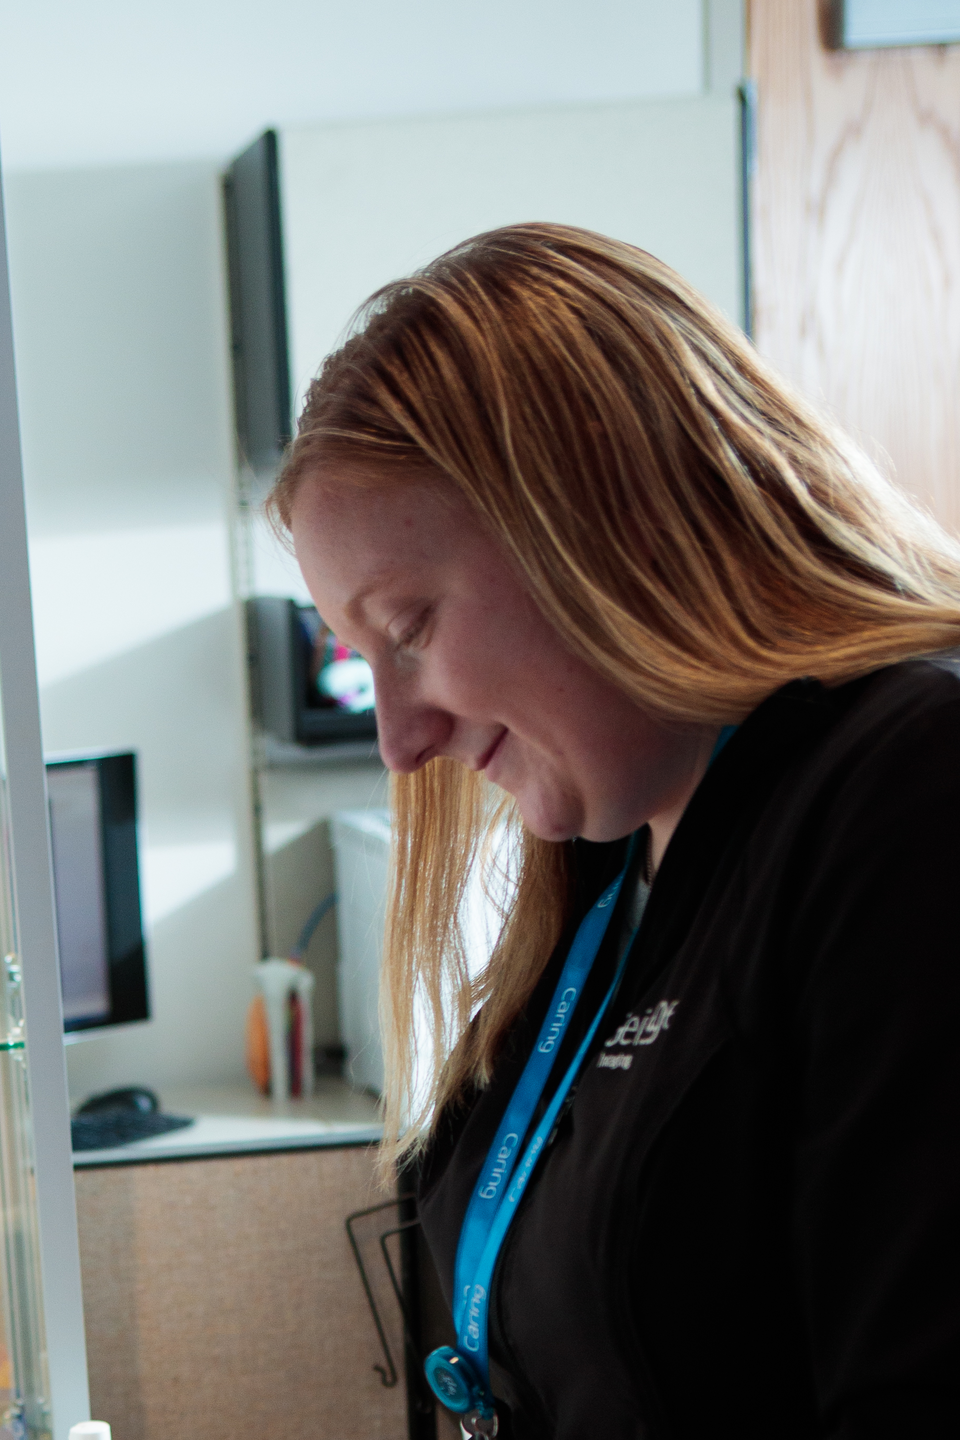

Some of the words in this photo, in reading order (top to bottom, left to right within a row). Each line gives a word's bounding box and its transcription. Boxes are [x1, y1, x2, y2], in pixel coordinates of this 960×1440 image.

[538, 987, 577, 1053] Caring
[477, 1132, 519, 1199] Caring
[463, 1283, 487, 1352] Caring
